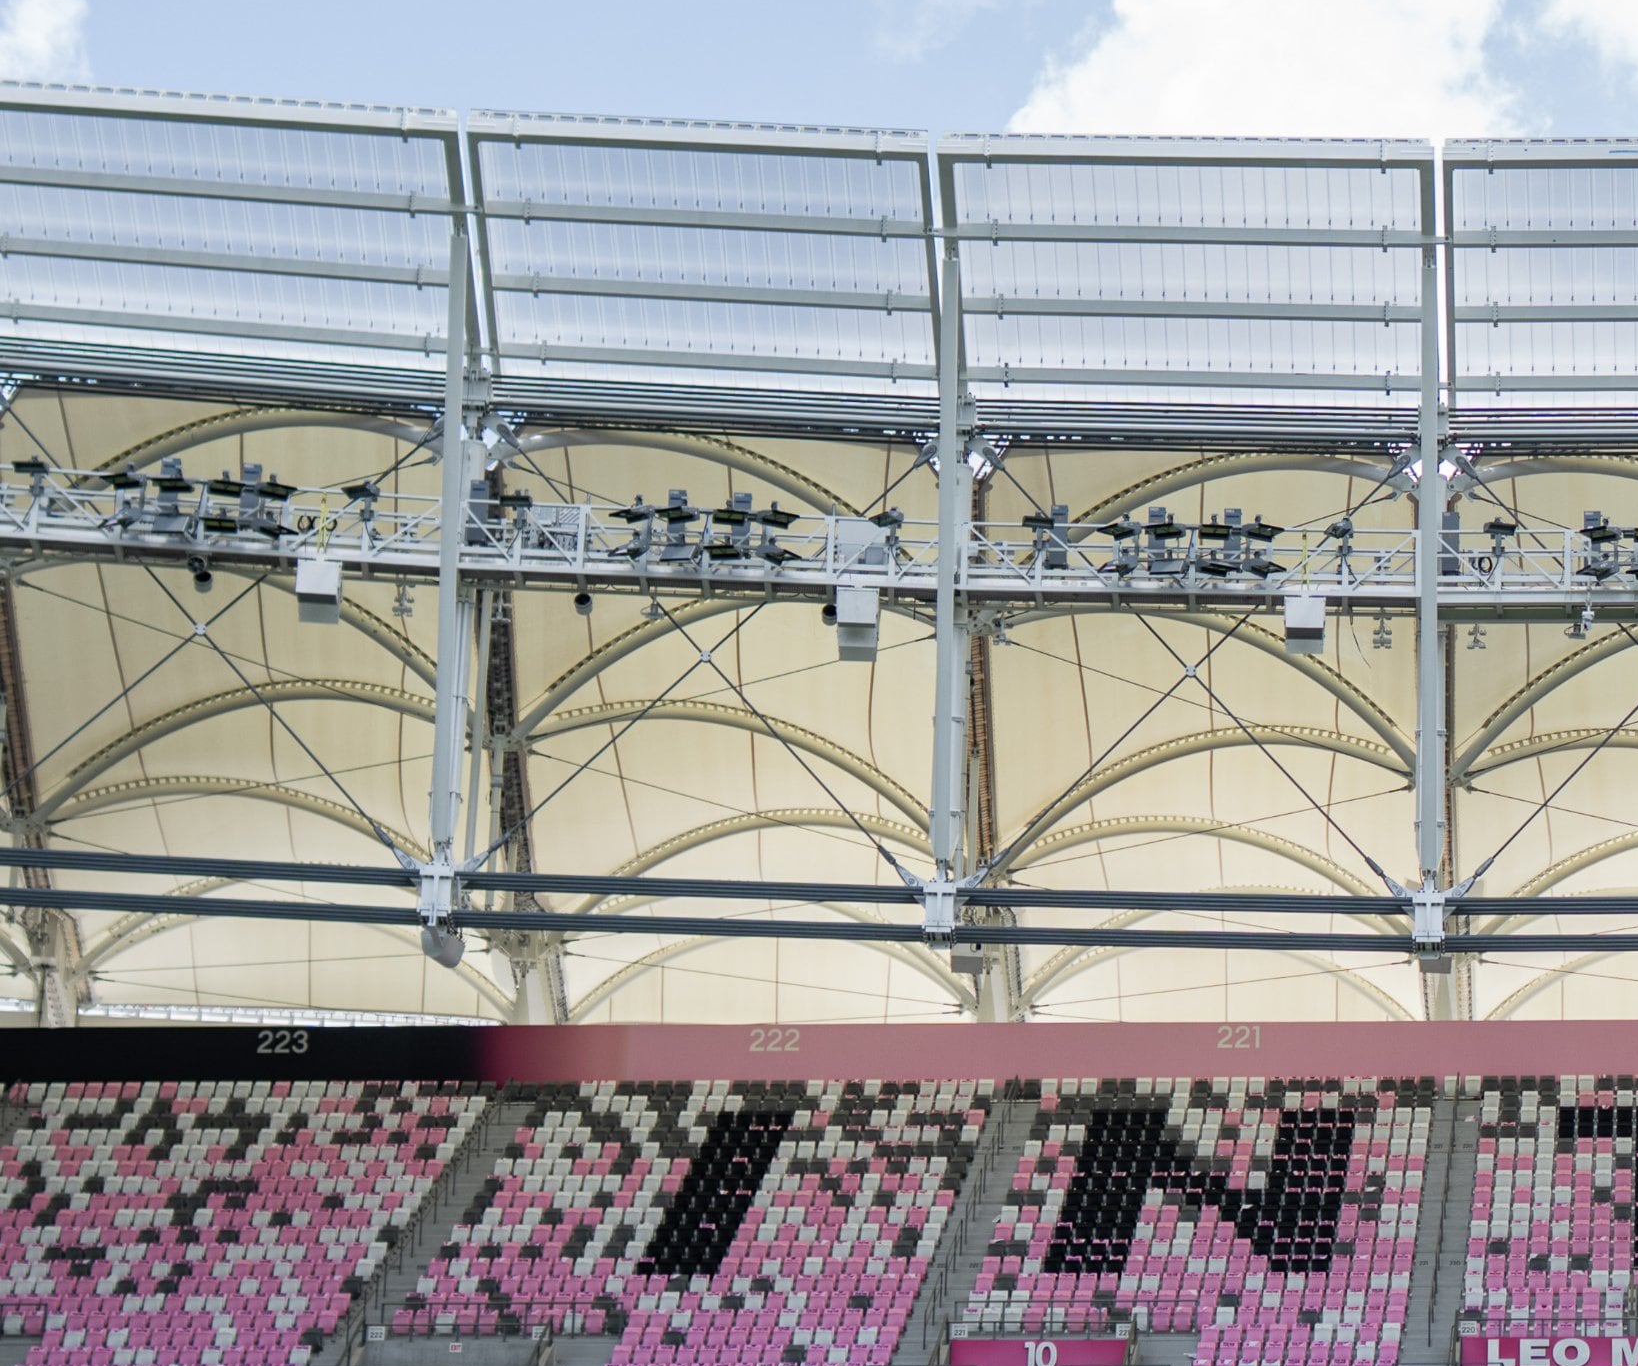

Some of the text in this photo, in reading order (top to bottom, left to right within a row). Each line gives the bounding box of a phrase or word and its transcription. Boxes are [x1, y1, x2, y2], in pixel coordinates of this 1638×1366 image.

[257, 1029, 310, 1054] 223
[749, 1028, 801, 1052] 222
[1216, 1025, 1262, 1049] 221
[1461, 1326, 1475, 1334] 220
